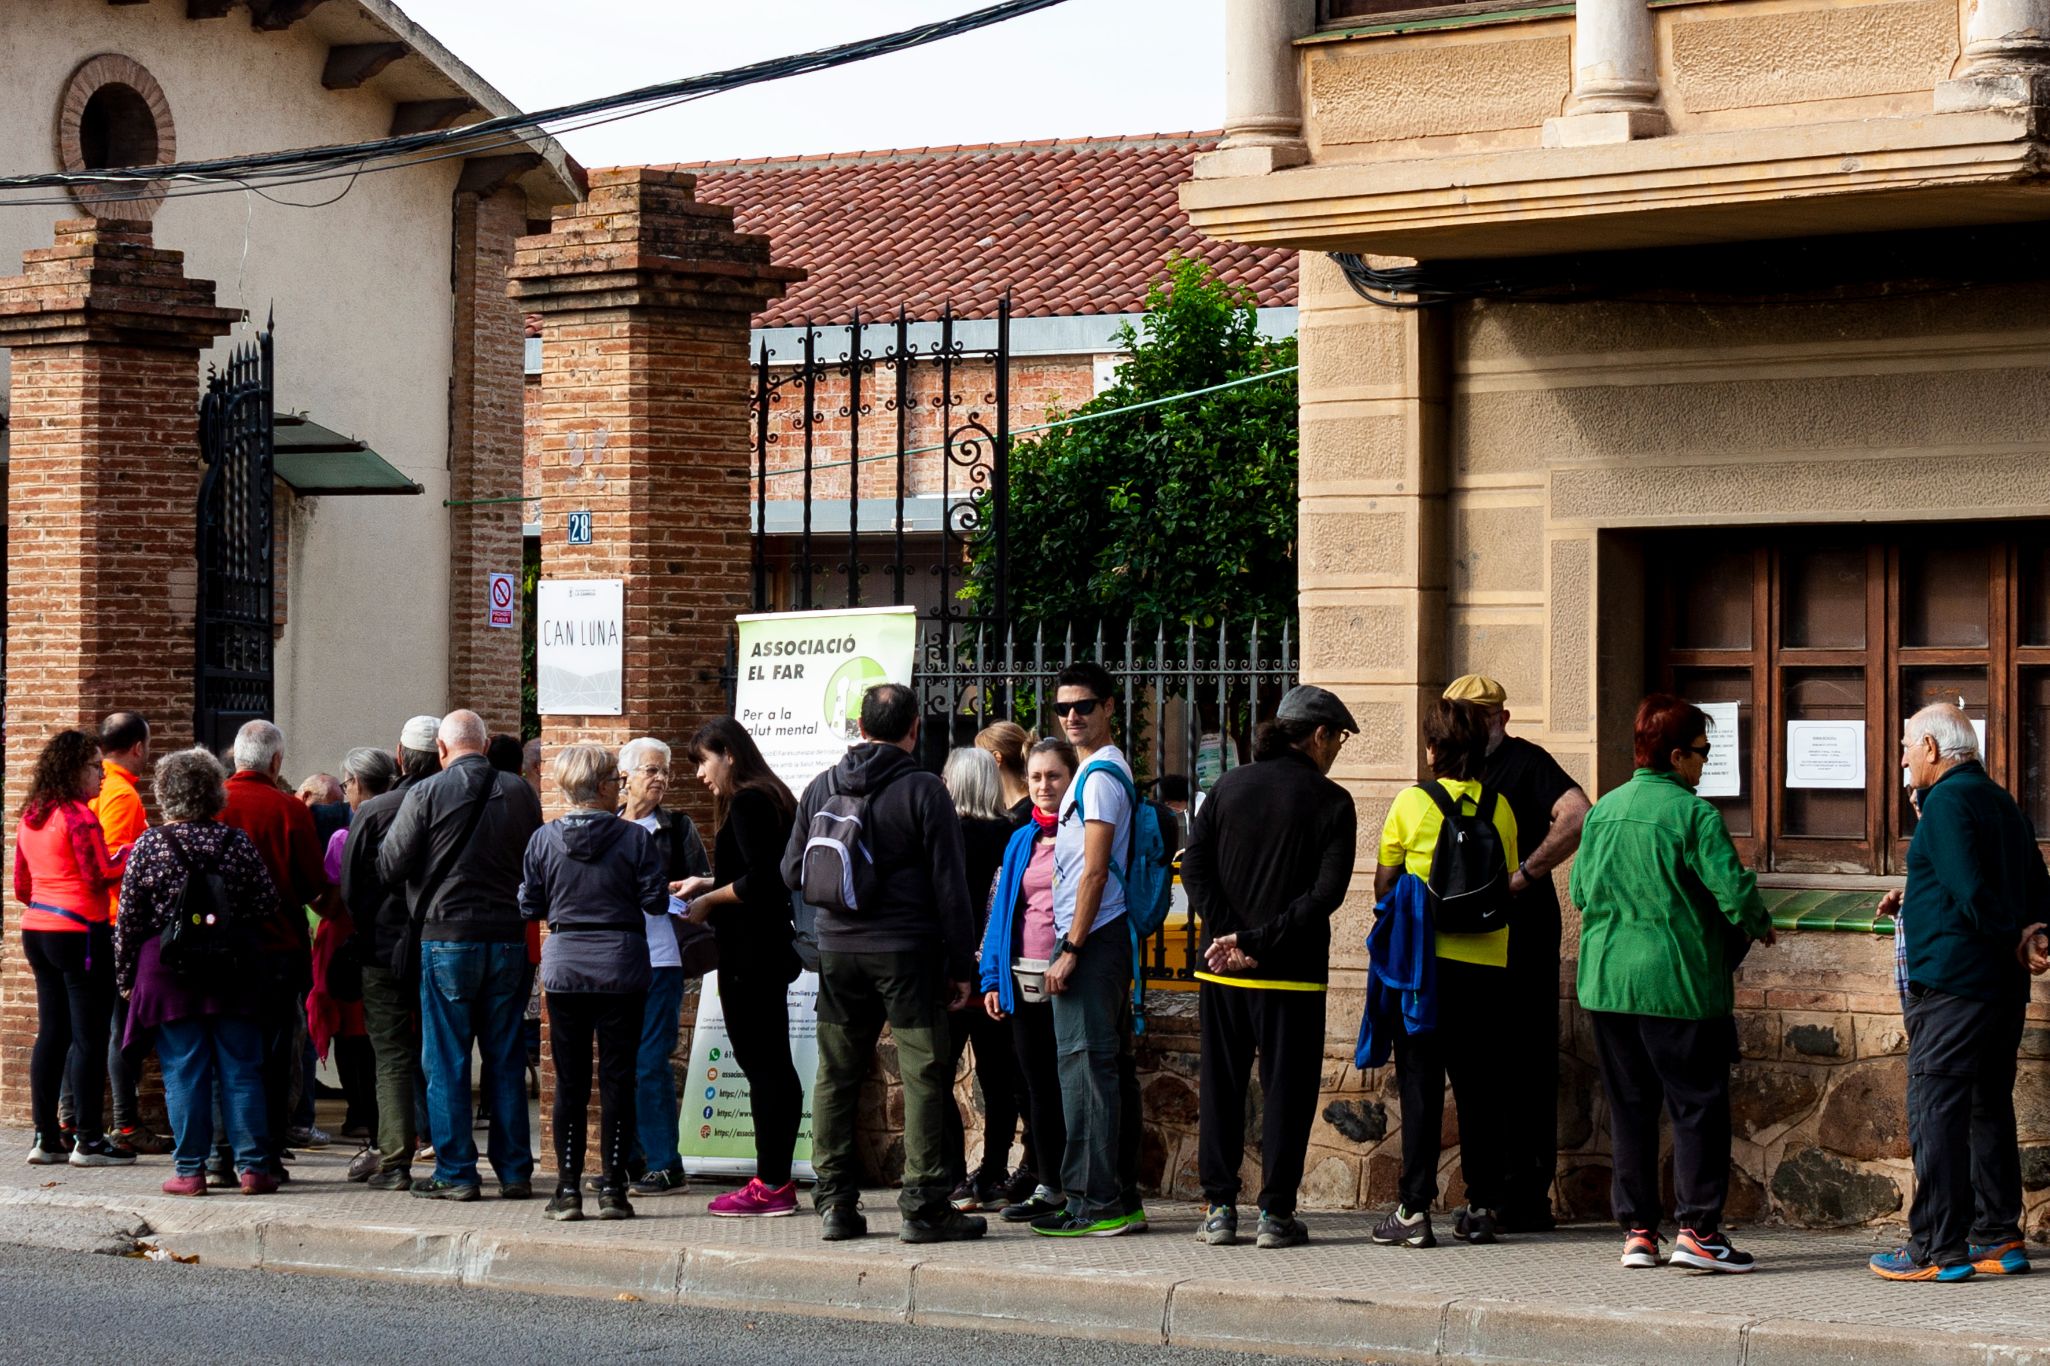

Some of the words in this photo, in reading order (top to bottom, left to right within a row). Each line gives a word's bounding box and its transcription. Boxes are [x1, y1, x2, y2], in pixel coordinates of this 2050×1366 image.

[571, 514, 589, 542] 28
[543, 619, 574, 647] CAN
[581, 619, 619, 647] LUNA
[751, 635, 856, 657] ASSOCIACIÓ
[748, 665, 765, 681] EL
[773, 663, 805, 680] FAR
[743, 708, 763, 720] Per
[768, 711, 776, 720] a
[780, 707, 792, 720] la
[747, 724, 772, 737] alut
[775, 721, 818, 736] mental
